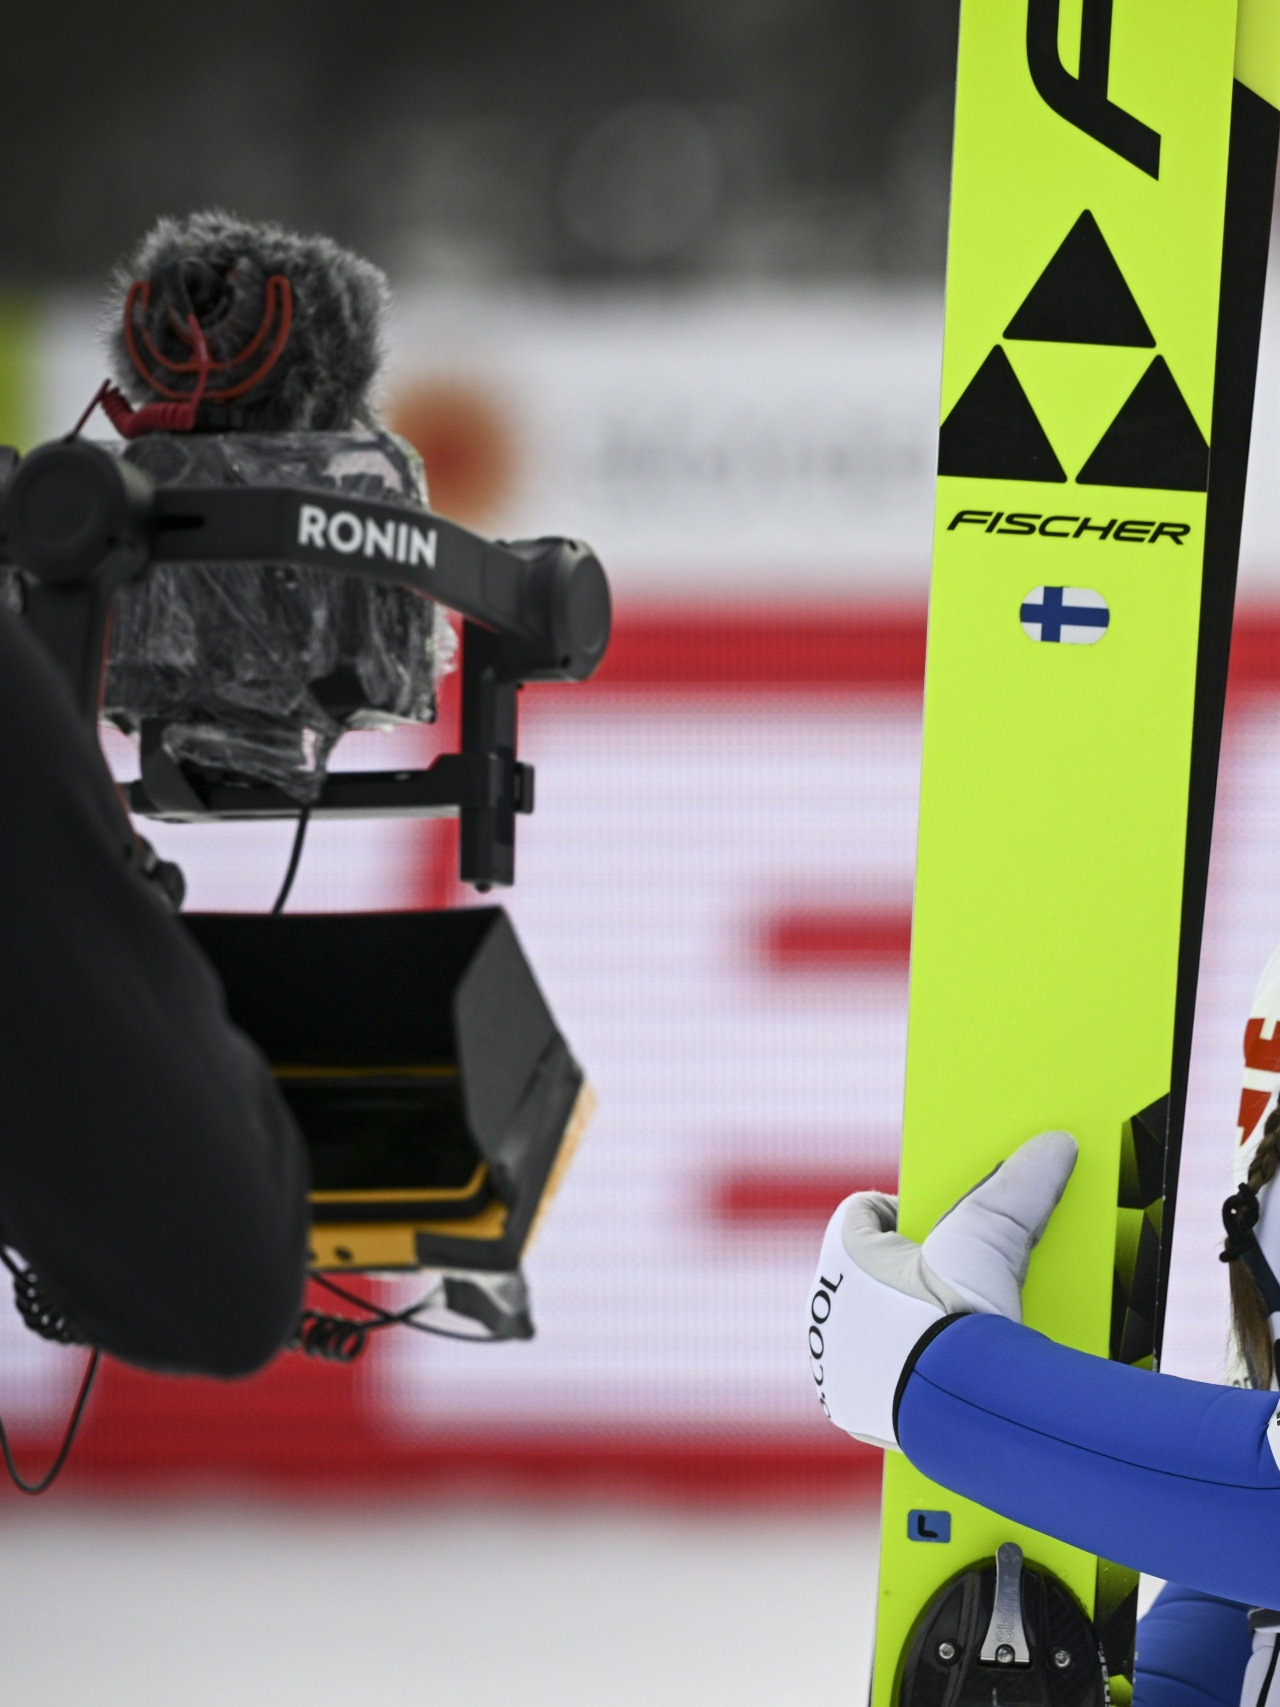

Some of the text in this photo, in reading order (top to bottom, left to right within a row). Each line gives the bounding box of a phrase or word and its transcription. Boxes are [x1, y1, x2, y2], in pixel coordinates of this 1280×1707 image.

[298, 504, 438, 569] RONIN
[947, 510, 1191, 545] FISCHER
[917, 1514, 939, 1538] L
